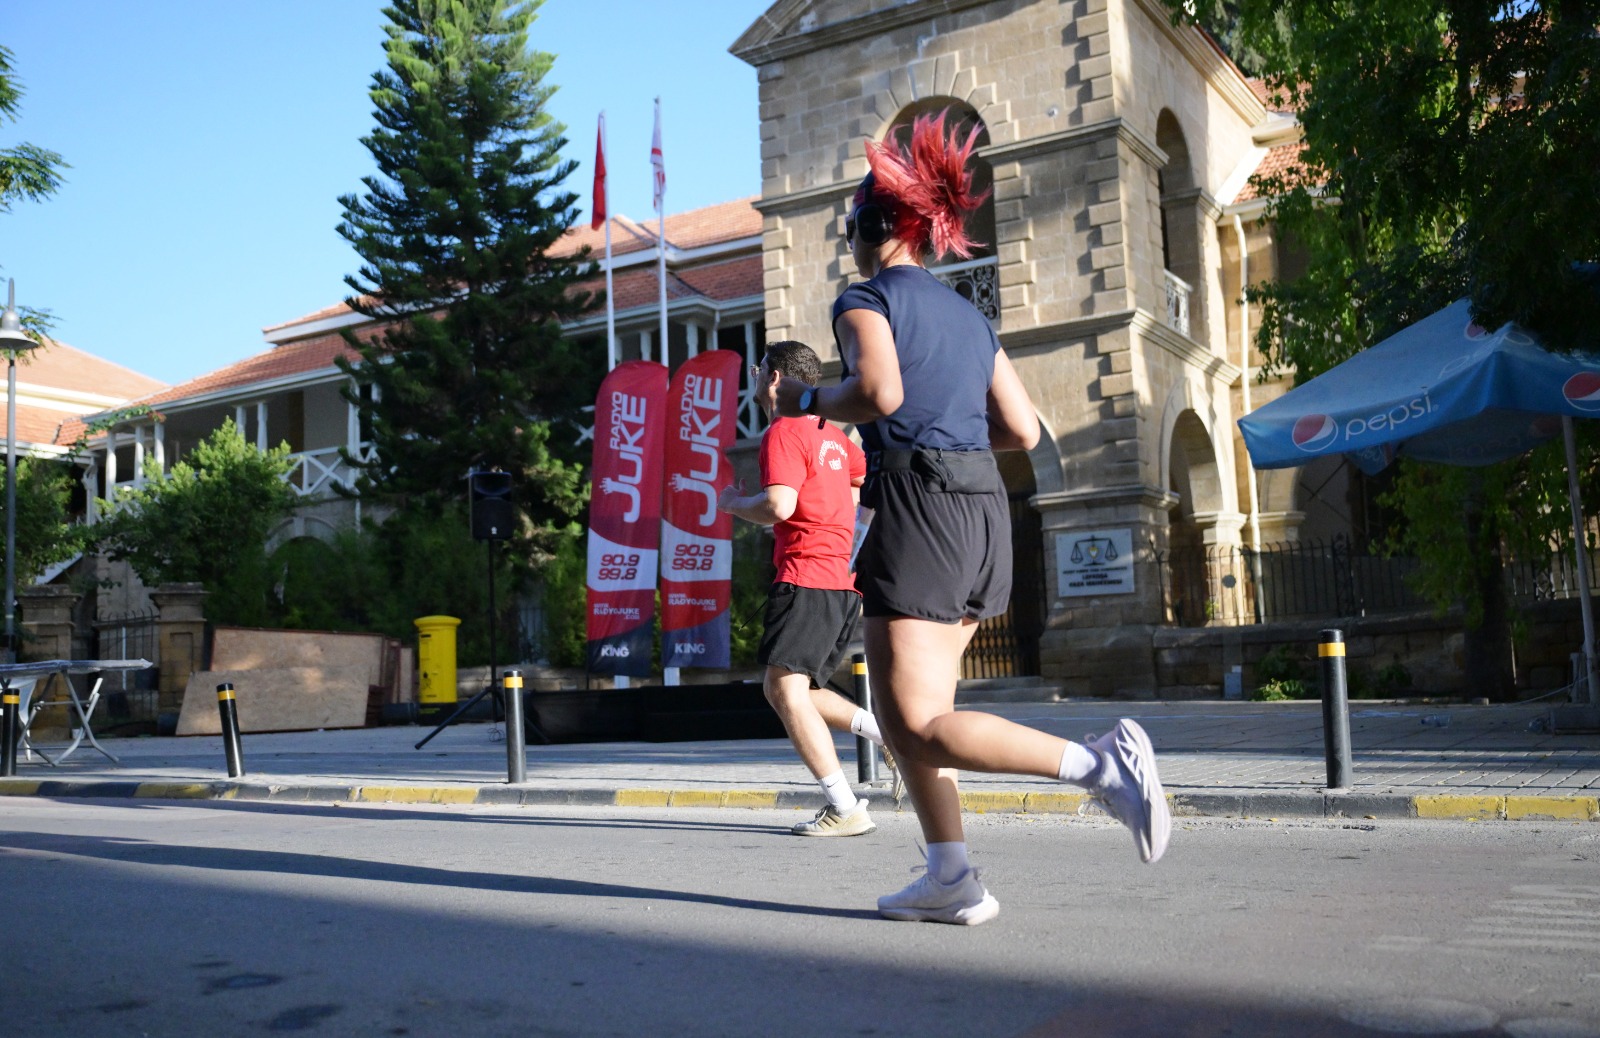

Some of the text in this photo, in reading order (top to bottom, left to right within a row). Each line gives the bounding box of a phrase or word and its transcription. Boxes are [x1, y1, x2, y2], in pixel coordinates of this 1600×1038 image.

[680, 374, 697, 441] RADYO
[609, 391, 624, 450] RADYO
[1345, 389, 1432, 441] pepsi
[672, 376, 723, 527] JUKE
[601, 394, 647, 523] JUKE
[674, 544, 715, 557] 90.9
[601, 554, 640, 567] 90.9
[671, 558, 713, 571] 99.8
[598, 568, 637, 580] 99.8
[601, 646, 630, 658] KING
[675, 643, 706, 654] KING
